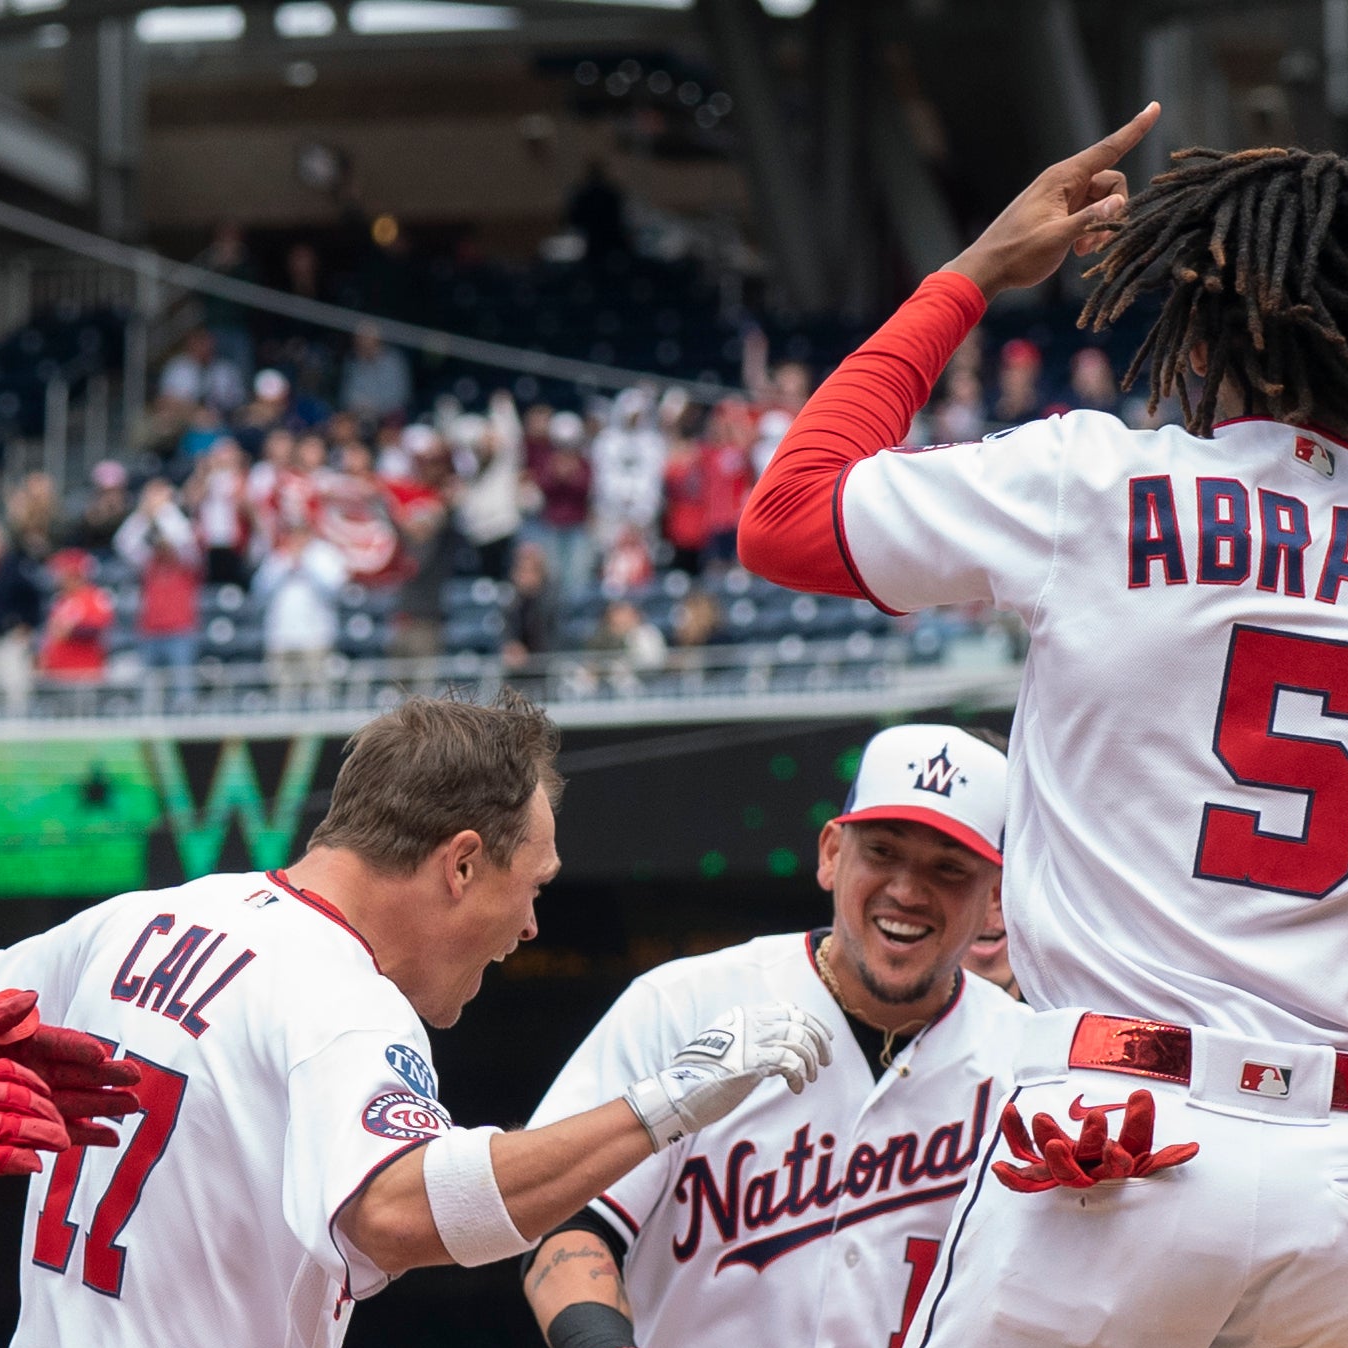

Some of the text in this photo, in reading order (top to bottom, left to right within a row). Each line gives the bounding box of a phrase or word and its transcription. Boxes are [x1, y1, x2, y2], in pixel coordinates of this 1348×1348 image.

[111, 913, 257, 1040] CALL
[32, 1032, 189, 1300] 17
[672, 1076, 993, 1264] National
